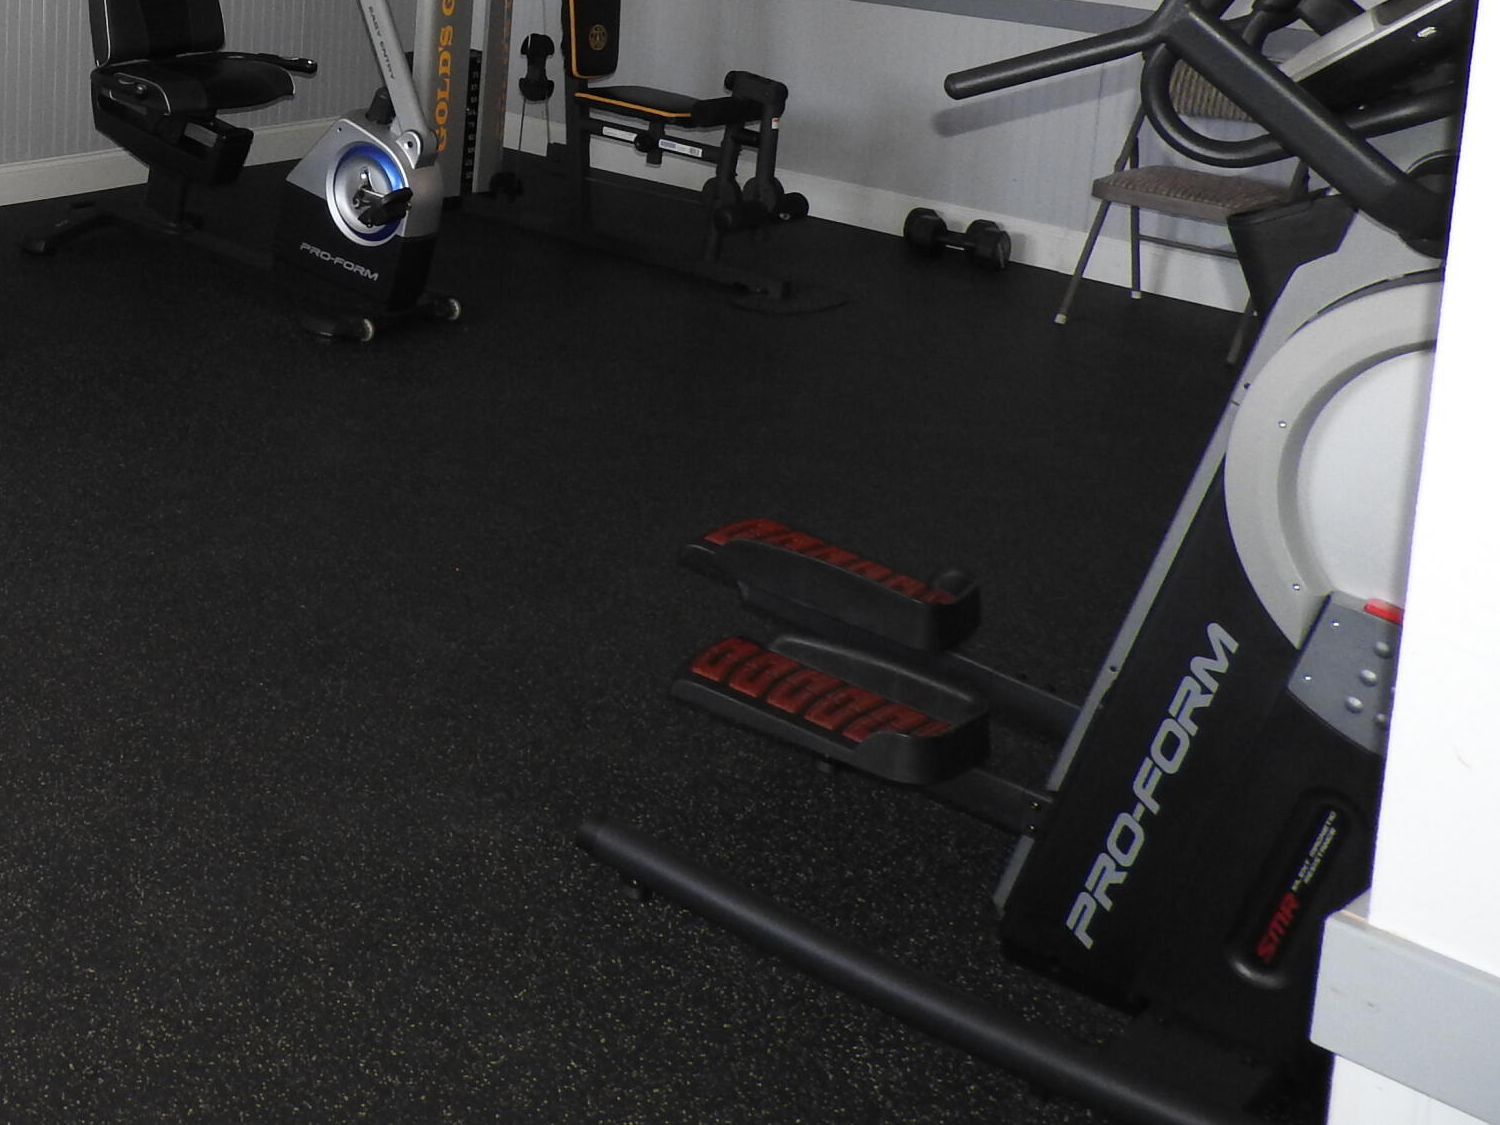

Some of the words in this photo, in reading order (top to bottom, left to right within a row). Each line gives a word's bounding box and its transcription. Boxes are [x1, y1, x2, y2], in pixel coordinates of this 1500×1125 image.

[435, 24, 453, 153] GOLD'S
[299, 242, 380, 282] PRO-FORM
[1065, 620, 1240, 951] PRO-FORM
